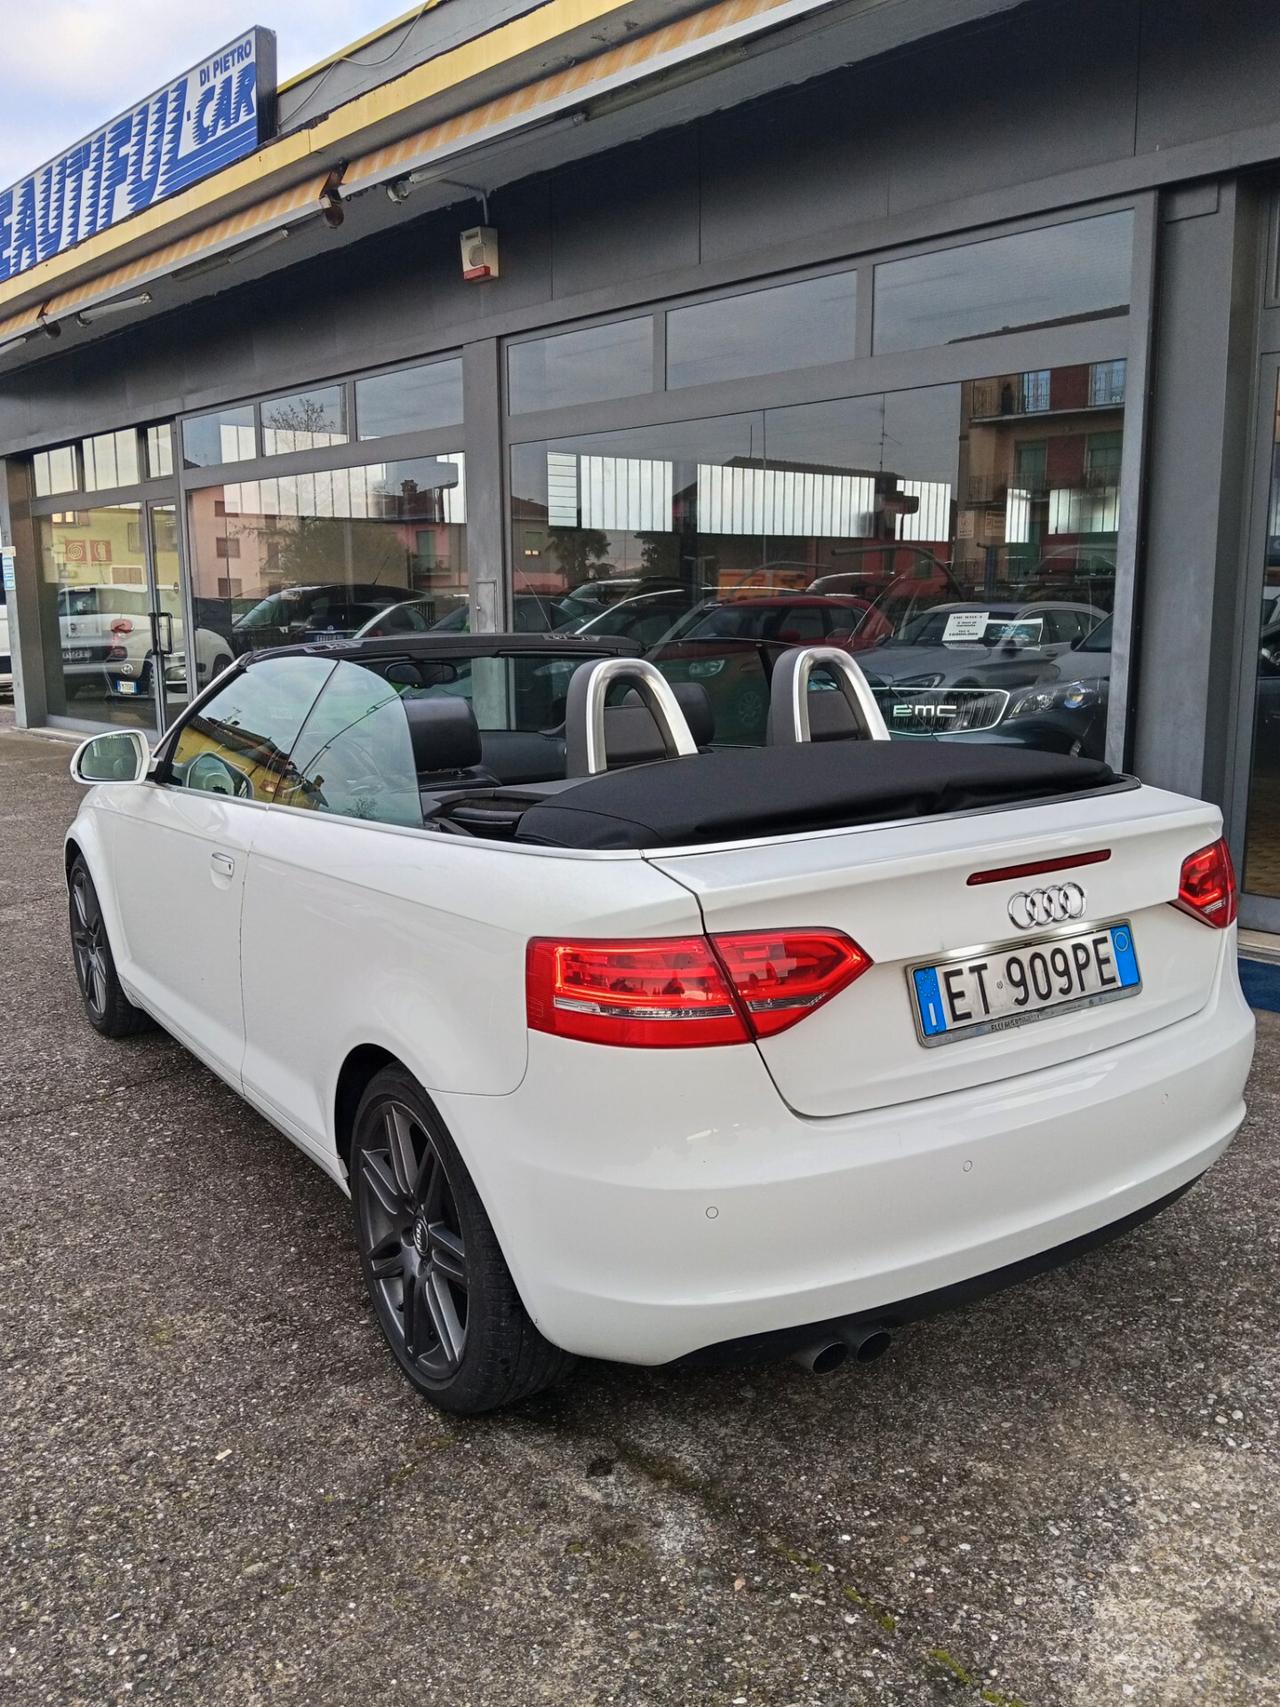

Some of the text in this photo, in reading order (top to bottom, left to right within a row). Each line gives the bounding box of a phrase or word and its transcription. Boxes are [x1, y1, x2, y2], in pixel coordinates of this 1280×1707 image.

[199, 40, 252, 87] DI PIETRO
[893, 704, 958, 717] EMC
[943, 963, 989, 1022] ET
[1006, 937, 1116, 1006] 909PE
